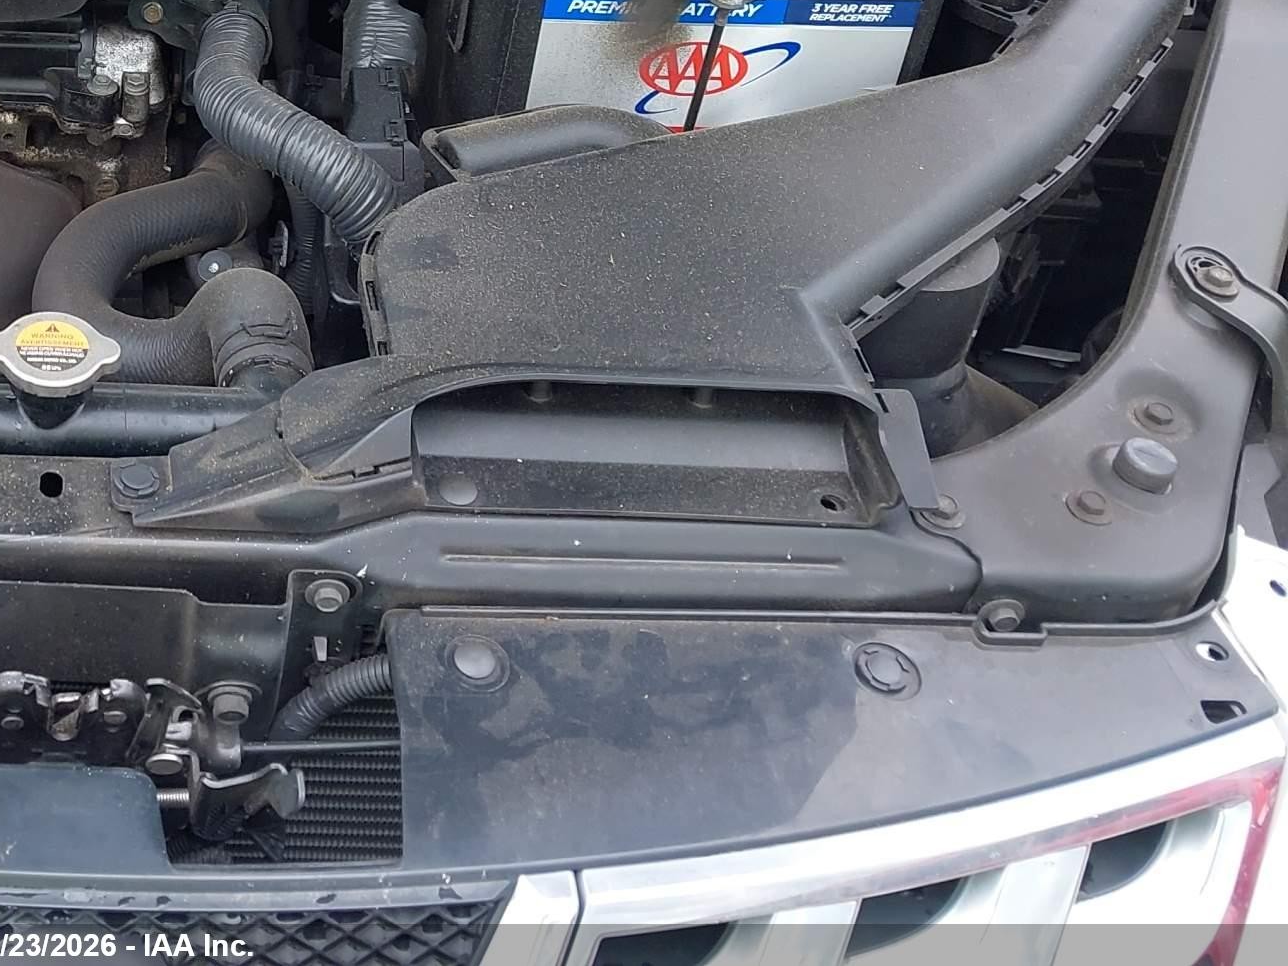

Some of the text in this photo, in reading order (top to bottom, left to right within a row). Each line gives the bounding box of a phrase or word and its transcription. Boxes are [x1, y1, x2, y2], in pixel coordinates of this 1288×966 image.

[567, 0, 765, 18] PREMI ATTRY
[811, 3, 895, 14] 3 YEAR FREE
[646, 42, 742, 94] AAA
[31, 332, 74, 340] WARNING
